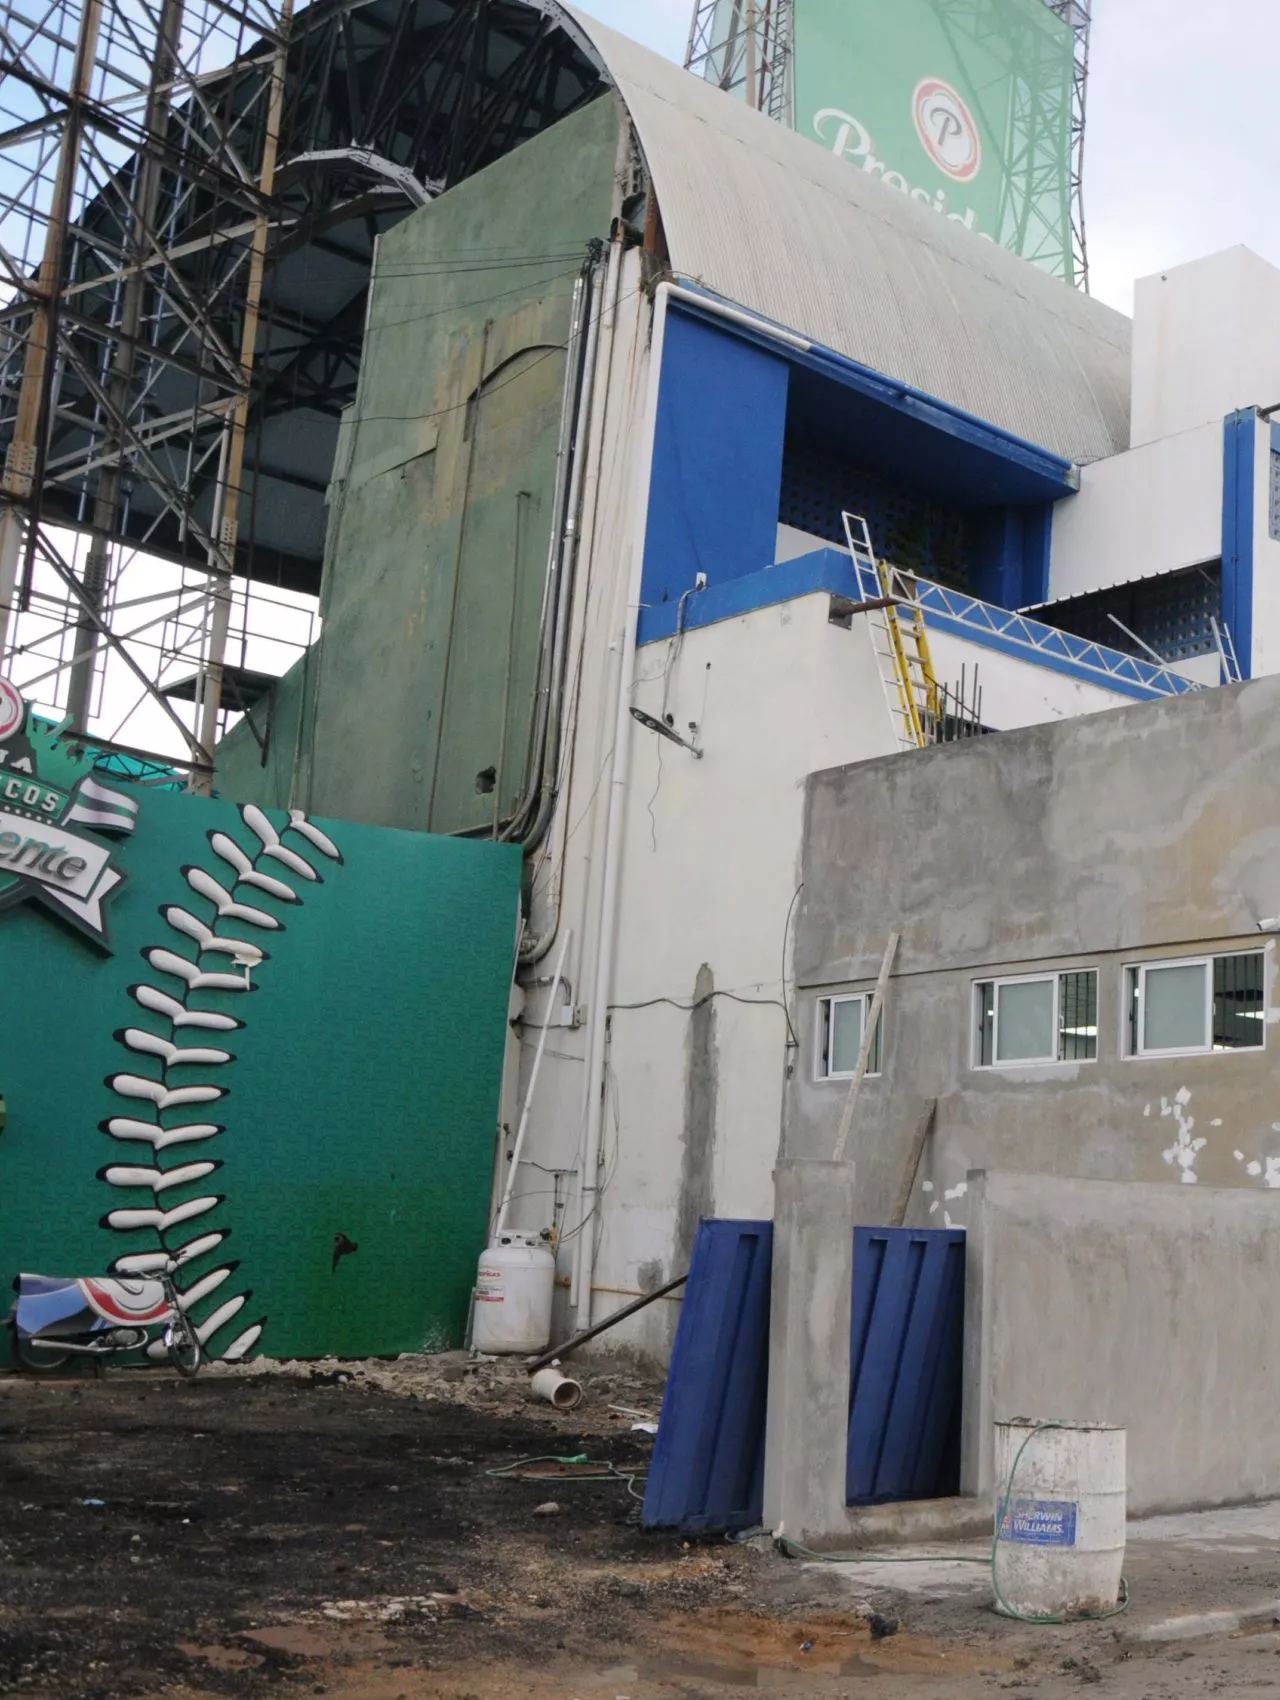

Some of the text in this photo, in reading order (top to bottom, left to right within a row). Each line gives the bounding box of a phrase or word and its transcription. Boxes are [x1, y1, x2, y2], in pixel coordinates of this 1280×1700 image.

[0, 776, 59, 812] COS
[0, 829, 87, 880] ente
[1013, 1519, 1064, 1534] WILLIAMS
